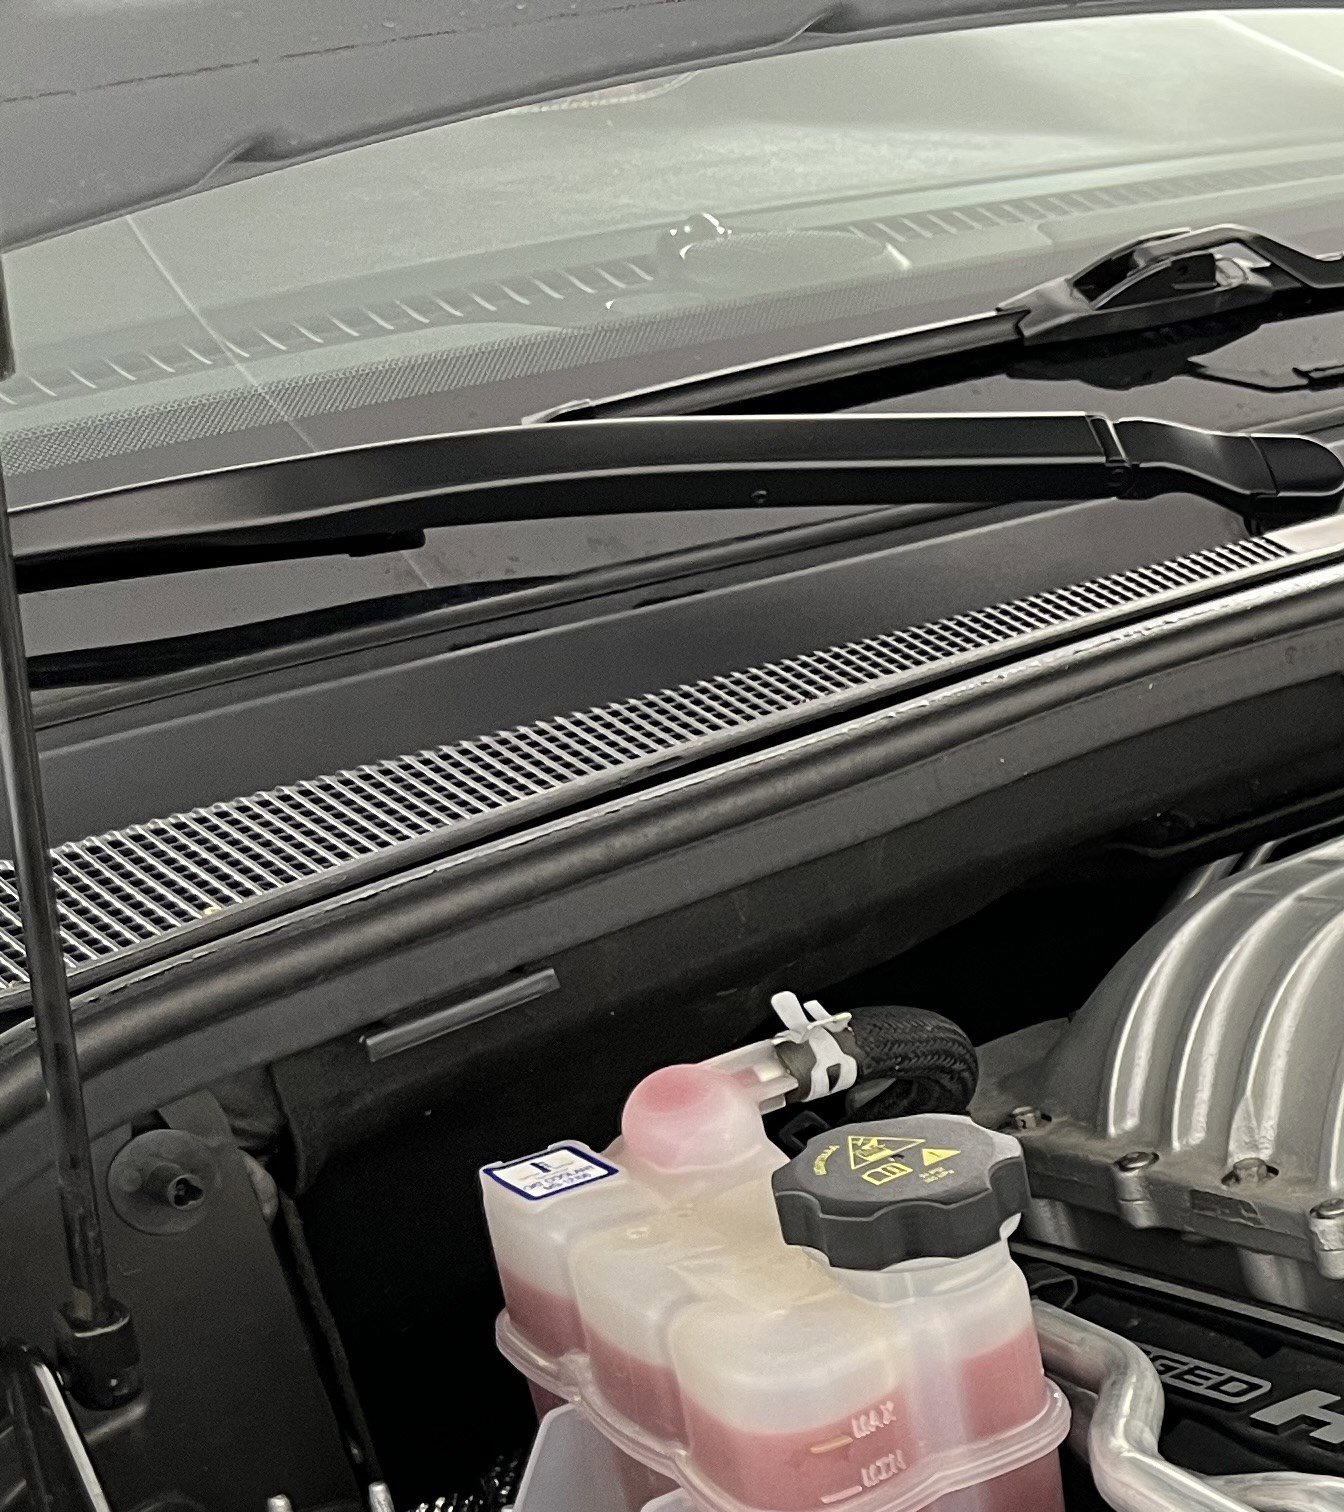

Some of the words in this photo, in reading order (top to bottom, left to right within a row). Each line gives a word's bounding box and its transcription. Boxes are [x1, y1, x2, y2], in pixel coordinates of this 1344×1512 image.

[1142, 1348, 1264, 1398] GED
[851, 1400, 897, 1438] MAX
[861, 1449, 907, 1487] MIN
